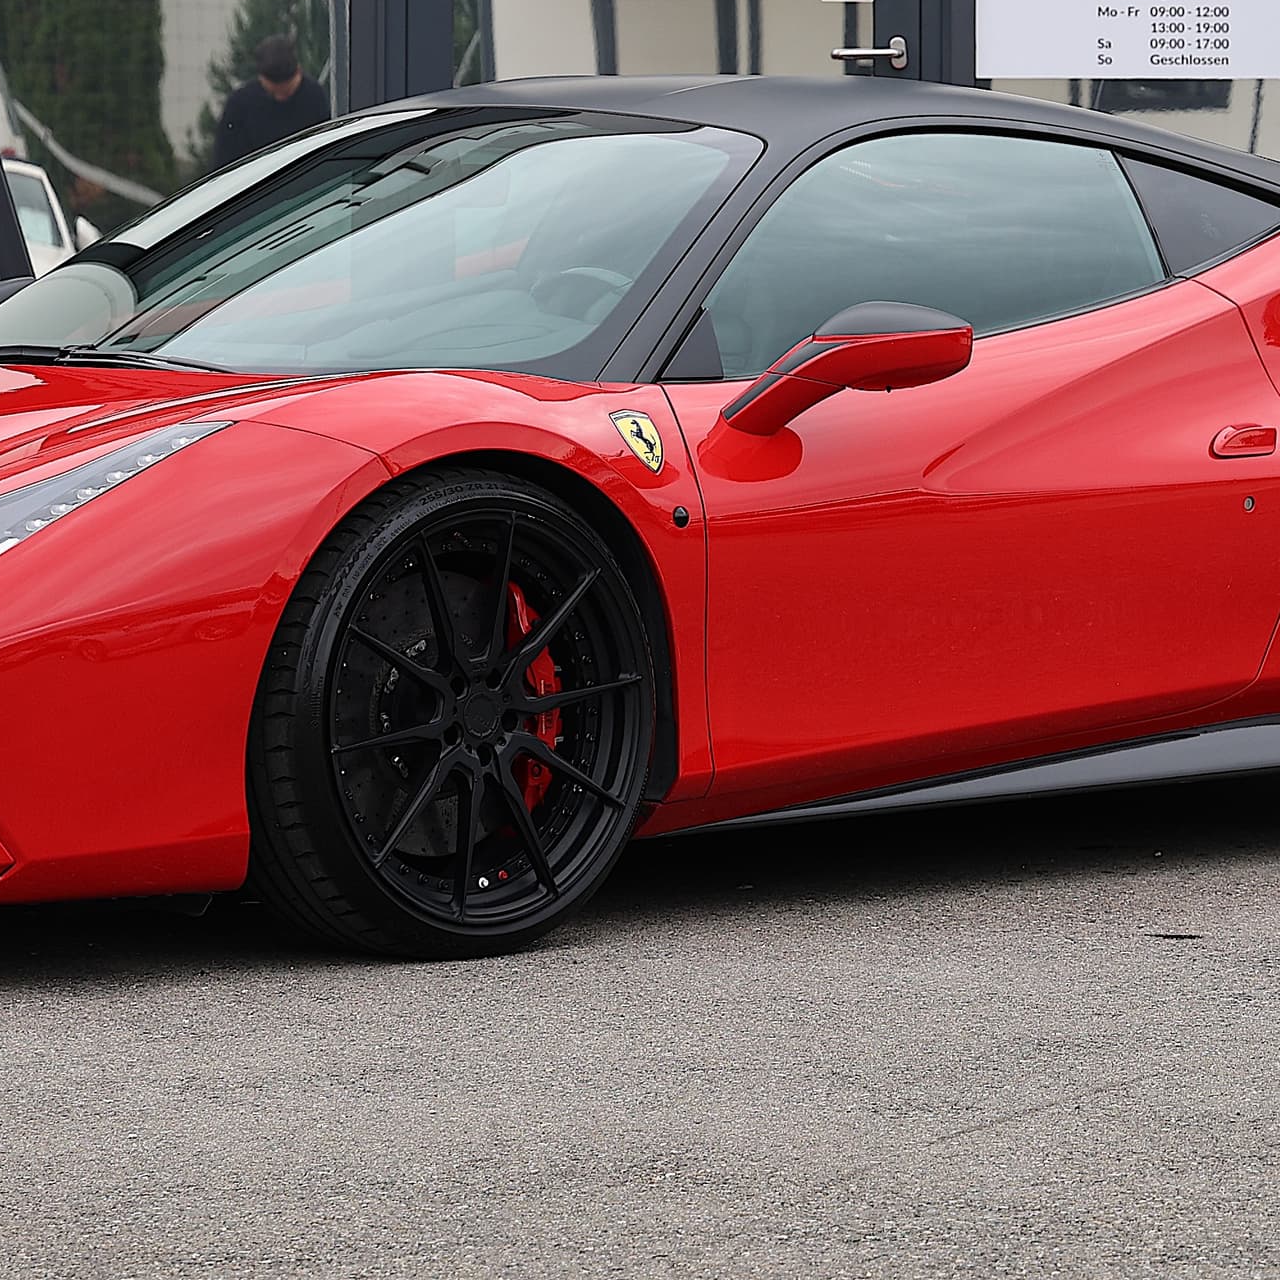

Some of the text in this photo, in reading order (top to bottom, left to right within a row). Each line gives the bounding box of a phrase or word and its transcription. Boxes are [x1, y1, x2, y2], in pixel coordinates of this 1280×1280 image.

[1097, 6, 1118, 17] Mo
[1127, 6, 1140, 17] Fr
[1150, 6, 1185, 17] 09:00
[1195, 6, 1230, 17] 12:00
[1151, 22, 1185, 33] 13:00
[1195, 22, 1230, 33] 19:00
[1097, 38, 1112, 49] Sa
[1150, 38, 1185, 49] 09:00
[1195, 38, 1230, 49] 17:00
[1097, 54, 1230, 65] So Geschlossen
[418, 485, 464, 506] 255/30
